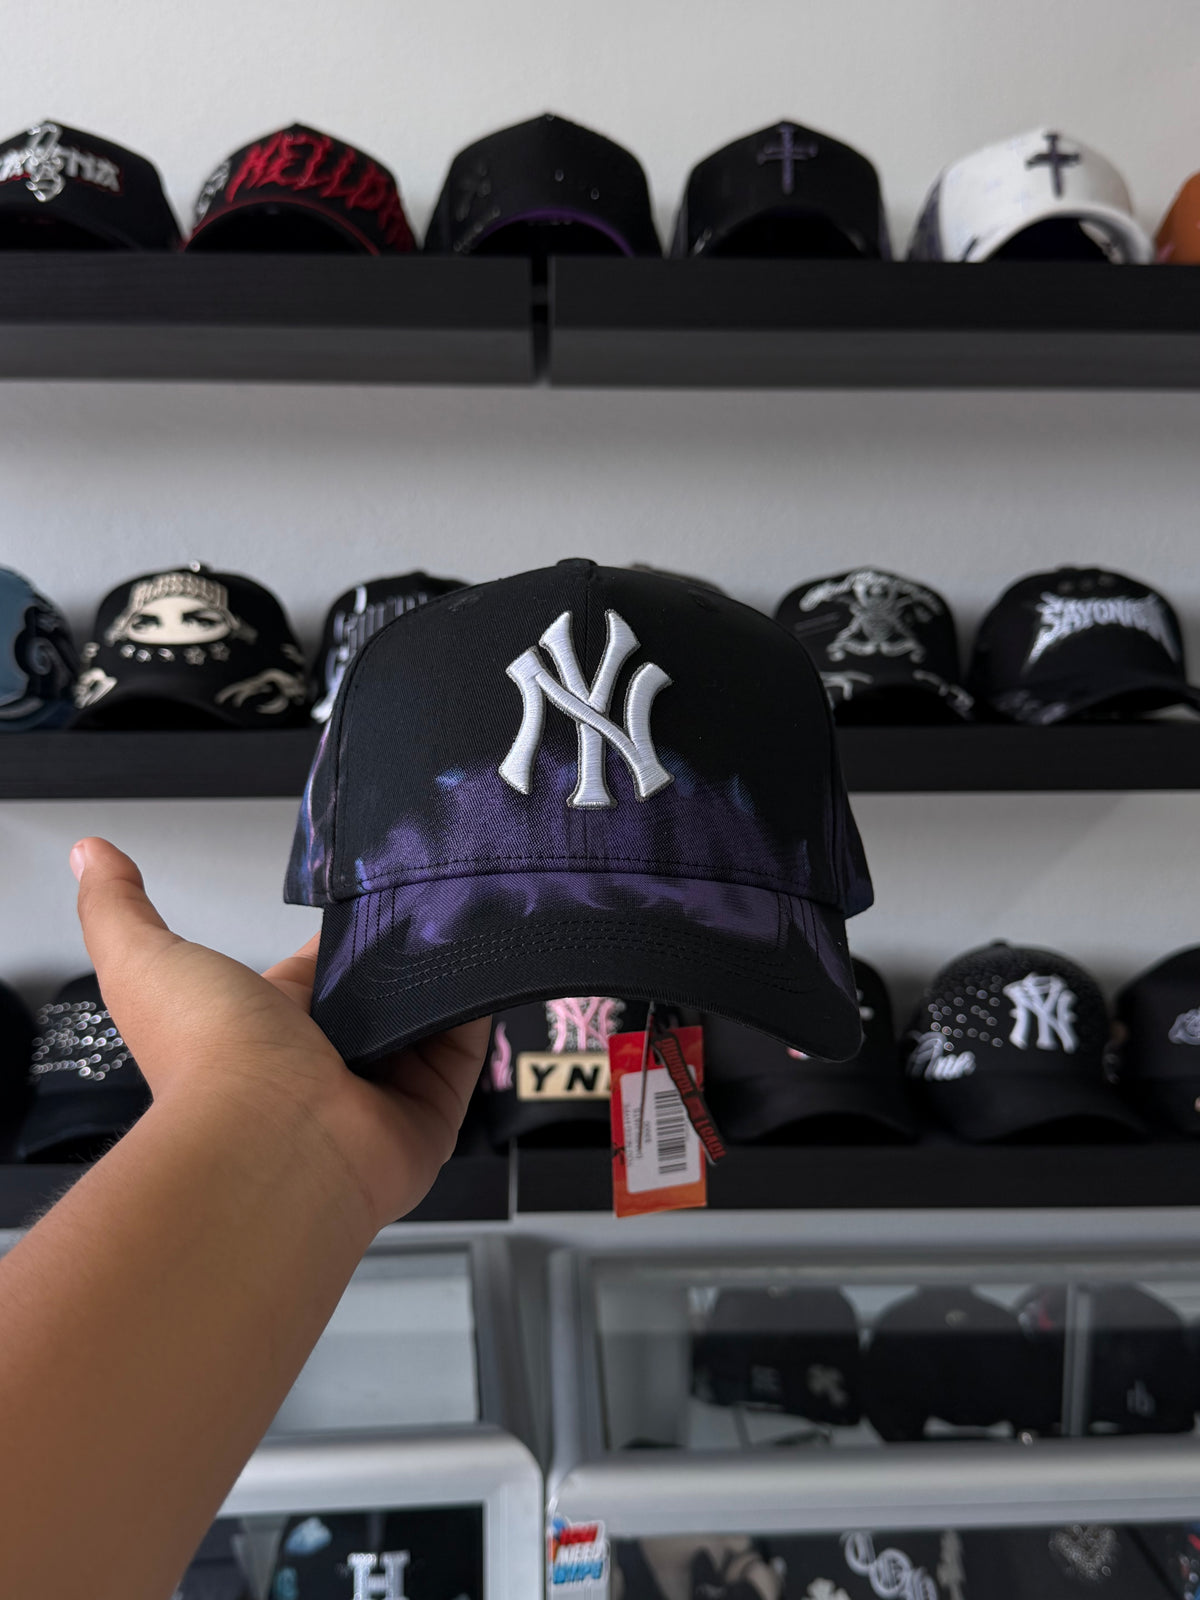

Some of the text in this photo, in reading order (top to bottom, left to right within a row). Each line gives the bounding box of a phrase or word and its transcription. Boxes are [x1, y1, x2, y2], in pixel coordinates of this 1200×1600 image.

[499, 609, 675, 810] NY
[1003, 971, 1078, 1054] NY
[530, 1062, 611, 1093] YN
